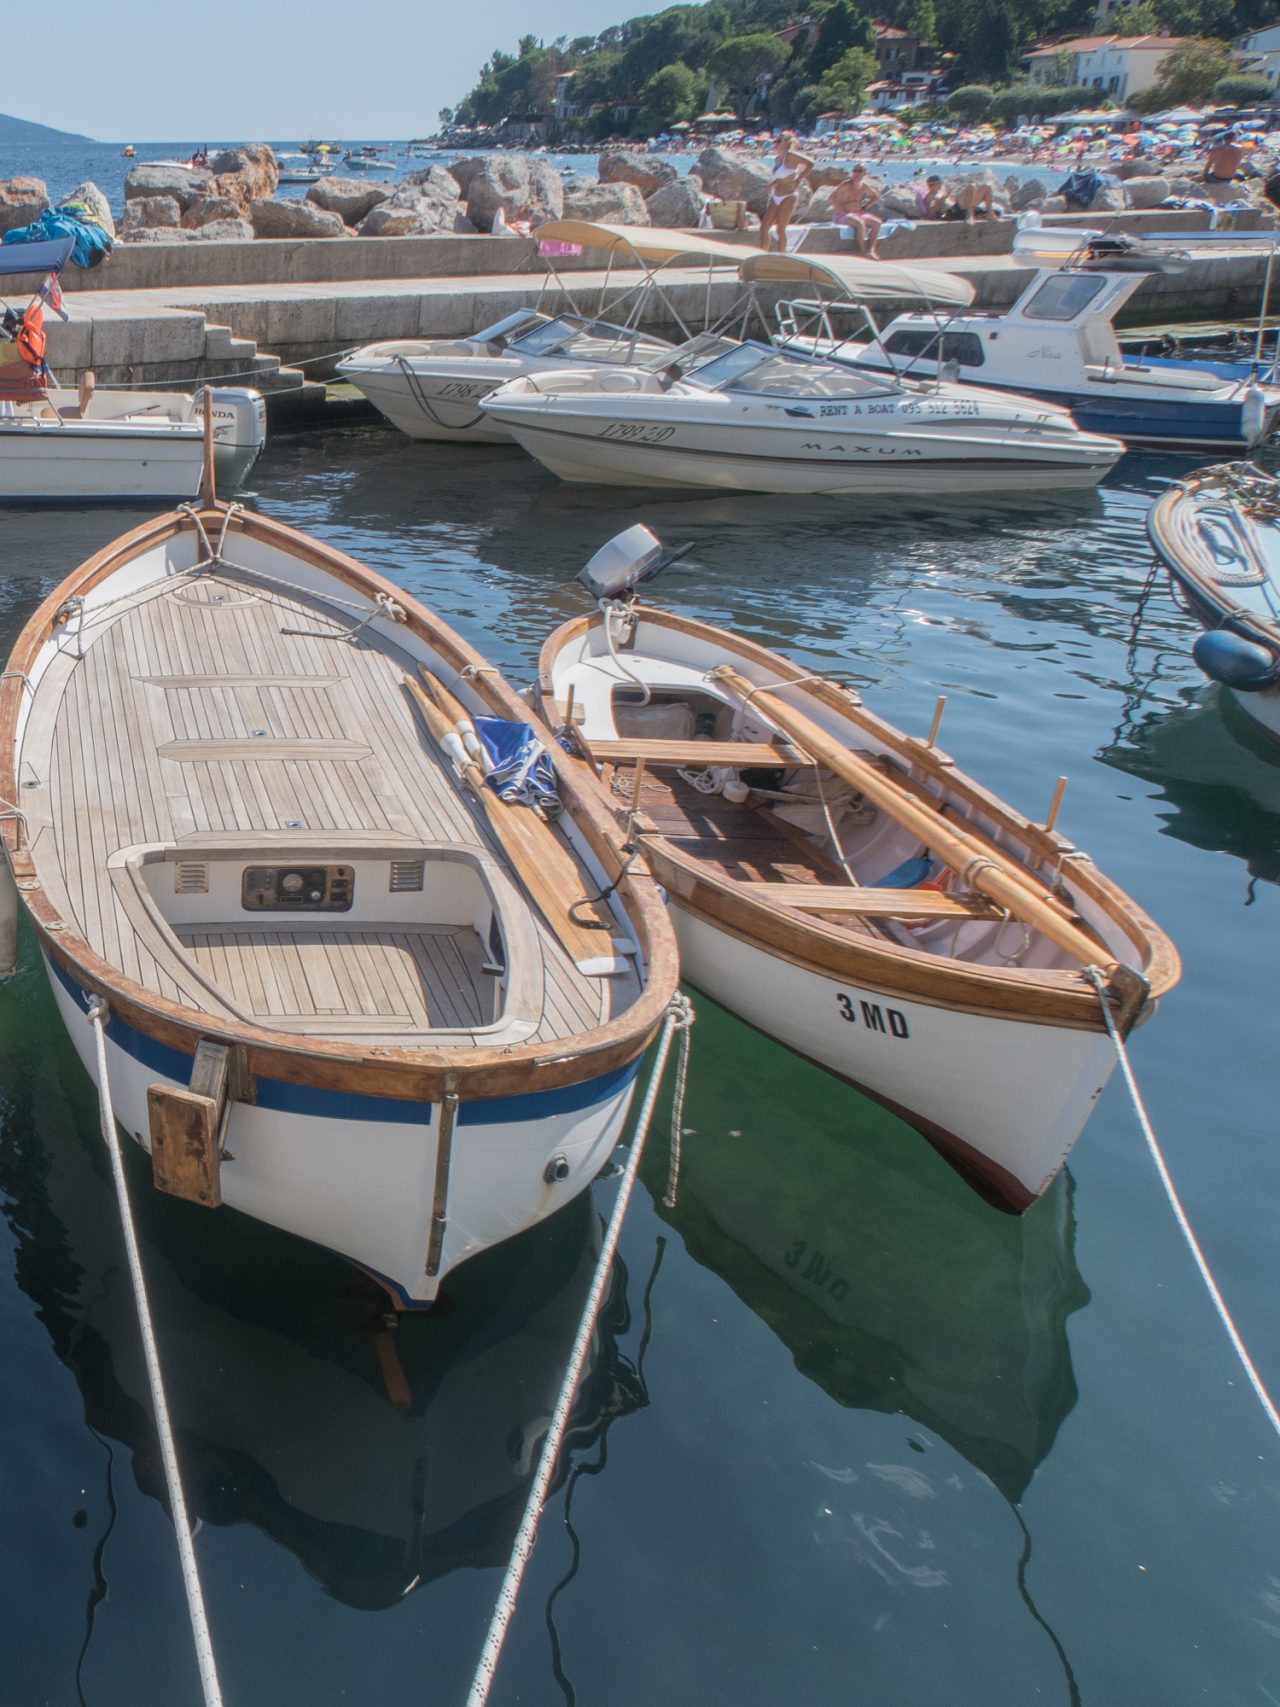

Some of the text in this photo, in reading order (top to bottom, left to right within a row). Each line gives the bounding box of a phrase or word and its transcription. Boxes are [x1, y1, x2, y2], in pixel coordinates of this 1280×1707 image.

[194, 407, 235, 420] HNDA
[820, 405, 848, 417] RENT
[854, 404, 863, 416] A
[868, 403, 896, 416] BOAT
[800, 442, 923, 456] MAXUM
[836, 992, 910, 1040] 3 MD
